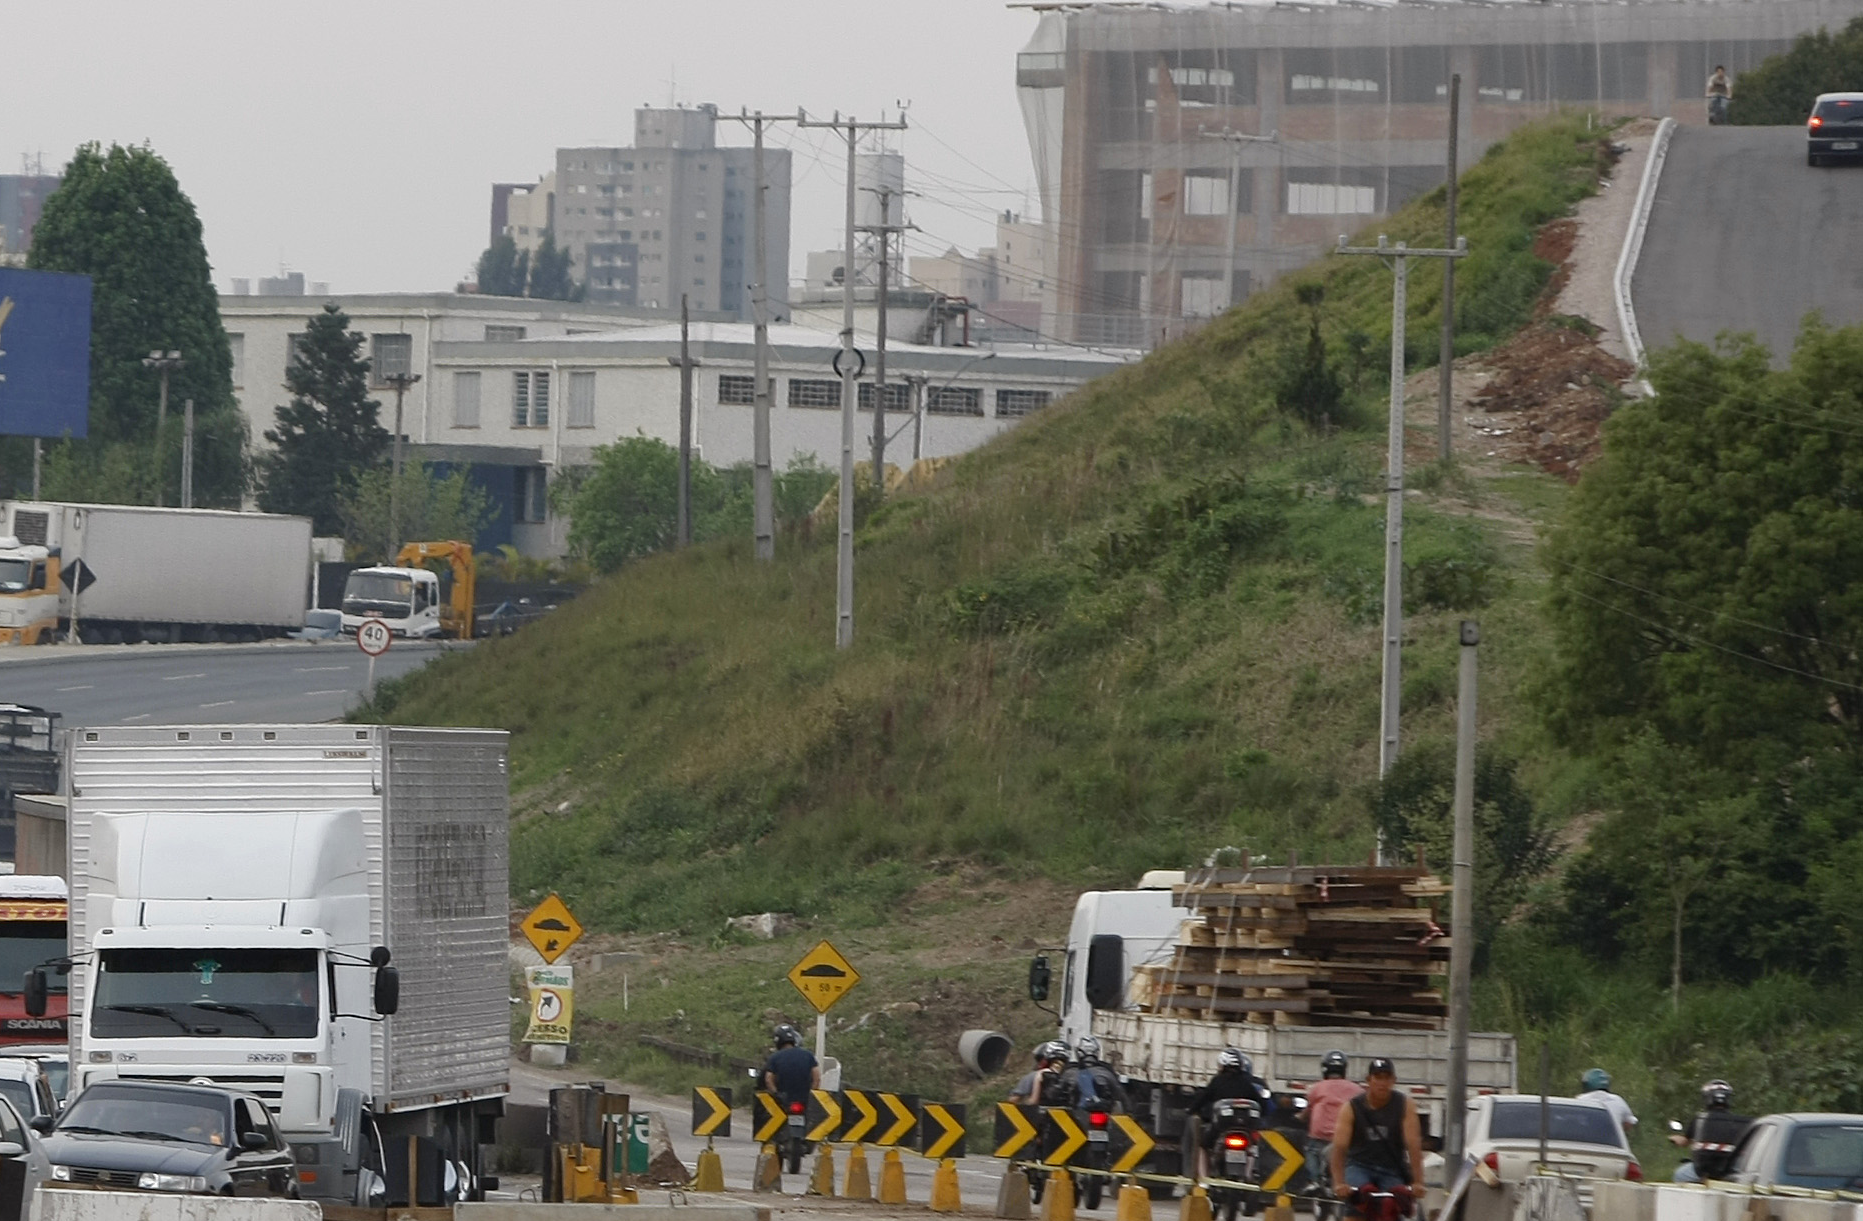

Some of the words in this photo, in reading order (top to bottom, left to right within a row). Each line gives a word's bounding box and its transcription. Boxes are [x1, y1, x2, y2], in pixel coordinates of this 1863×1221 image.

[365, 627, 383, 641] 40
[819, 983, 830, 992] 50
[7, 1019, 62, 1030] SCANIA
